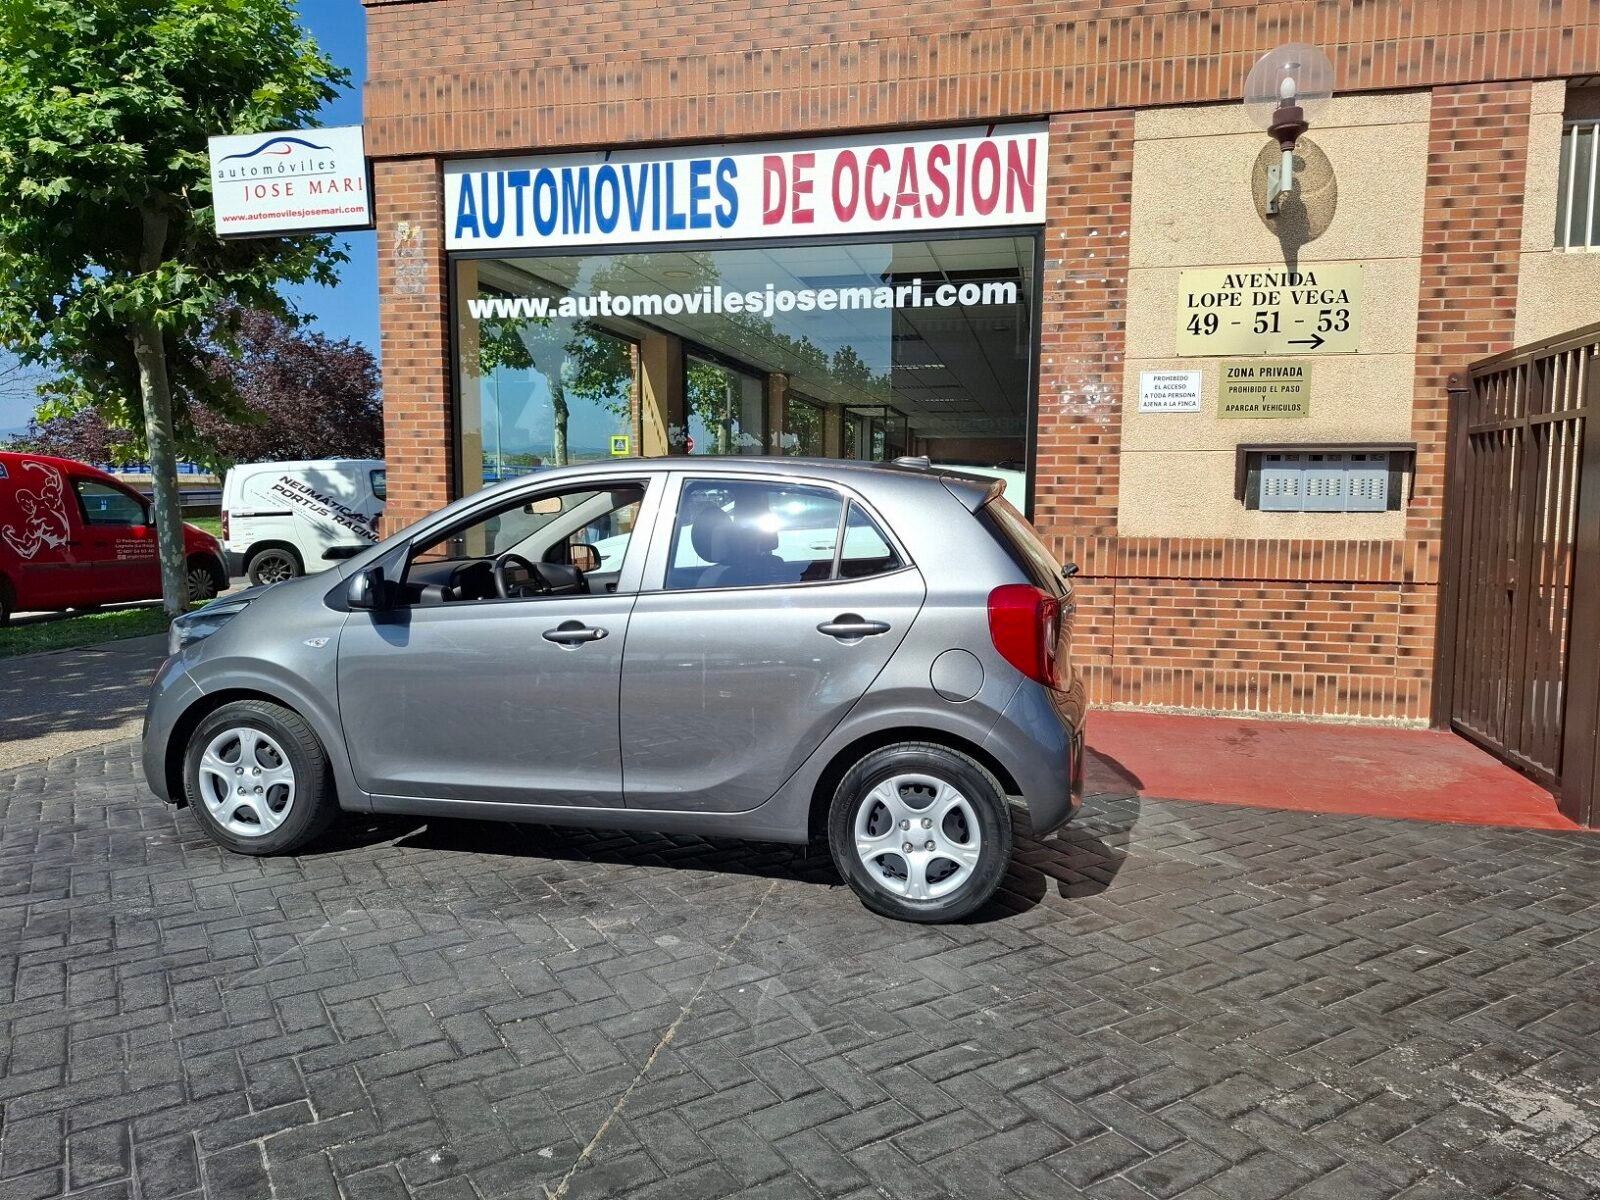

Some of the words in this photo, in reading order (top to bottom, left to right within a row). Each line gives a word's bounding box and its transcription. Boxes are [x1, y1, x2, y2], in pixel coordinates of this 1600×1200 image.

[218, 159, 336, 179] automóviles
[244, 182, 294, 201] JOSE
[309, 177, 363, 195] MARI
[763, 153, 815, 225] DE
[222, 205, 364, 222] www.automovilesjosemari.com
[1221, 271, 1317, 289] AVENIDA
[467, 278, 1017, 319] www.automovilesjosemari.com
[1187, 292, 1242, 308] LOPE
[1252, 291, 1280, 306] DE
[1291, 289, 1350, 305] VEGA
[1187, 312, 1219, 336] 49
[1253, 311, 1281, 334] 51
[1317, 309, 1350, 333] 53
[1227, 368, 1254, 377] ZONA
[1260, 367, 1303, 377] PRIVADA
[1229, 385, 1267, 393] PROHIBIDO
[271, 484, 330, 516] PORTUS
[279, 476, 370, 524] NEUMÁTICAS
